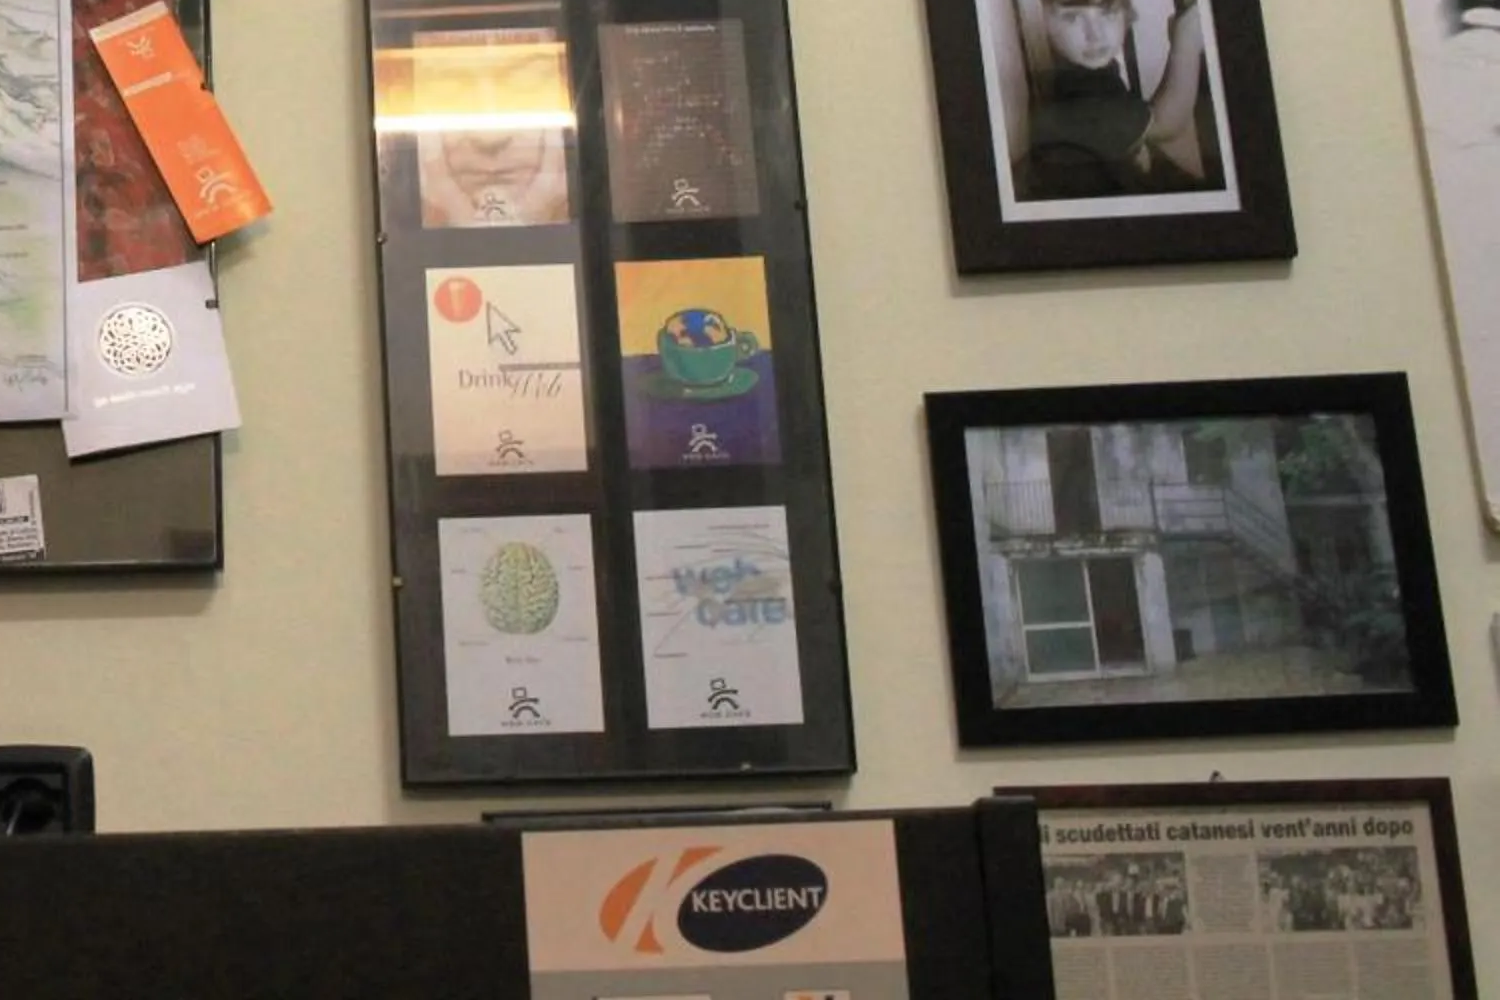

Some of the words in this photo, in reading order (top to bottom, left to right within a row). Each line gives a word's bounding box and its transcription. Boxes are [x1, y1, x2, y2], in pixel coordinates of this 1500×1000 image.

[459, 368, 516, 389] Drink
[1055, 821, 1160, 844] scudettati
[1166, 819, 1255, 841] catanesi
[1261, 816, 1357, 839] vent'anni
[1363, 816, 1415, 839] dopo
[692, 886, 824, 914] KEYCLIENT
